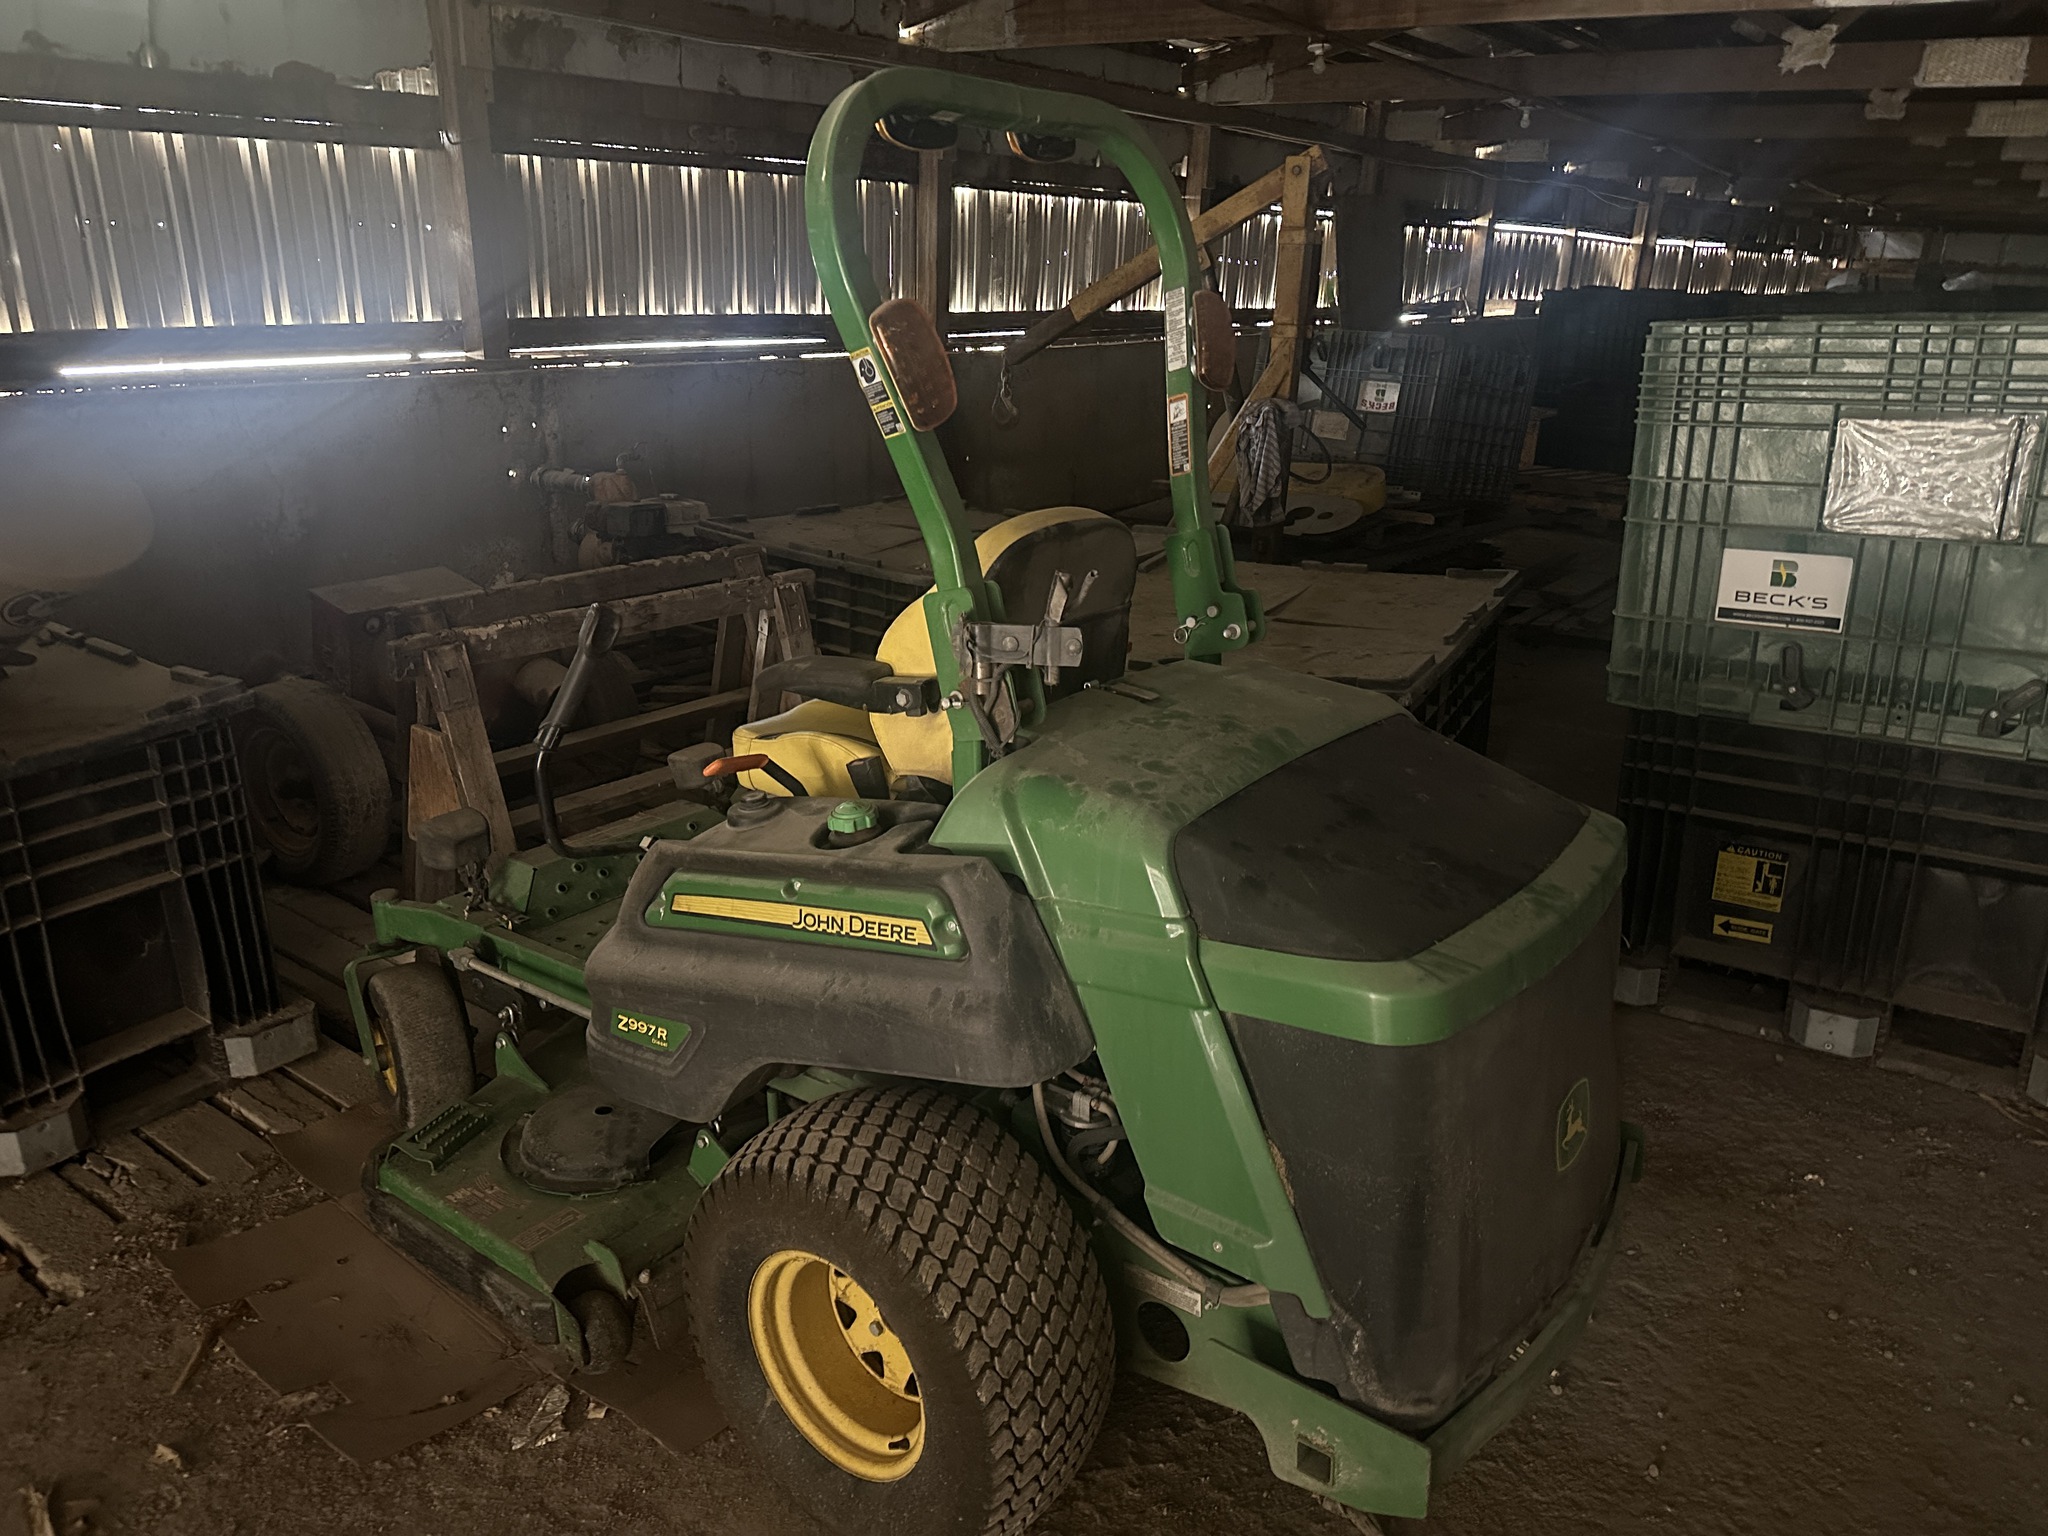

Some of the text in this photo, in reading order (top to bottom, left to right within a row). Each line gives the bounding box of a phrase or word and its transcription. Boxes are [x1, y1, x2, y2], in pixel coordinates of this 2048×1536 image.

[1361, 399, 1395, 410] BECK'S
[1735, 590, 1828, 610] BECK'S
[1737, 846, 1783, 860] CAUTION
[792, 908, 917, 941] JOHN DEERE
[617, 1014, 668, 1041] Z997R
